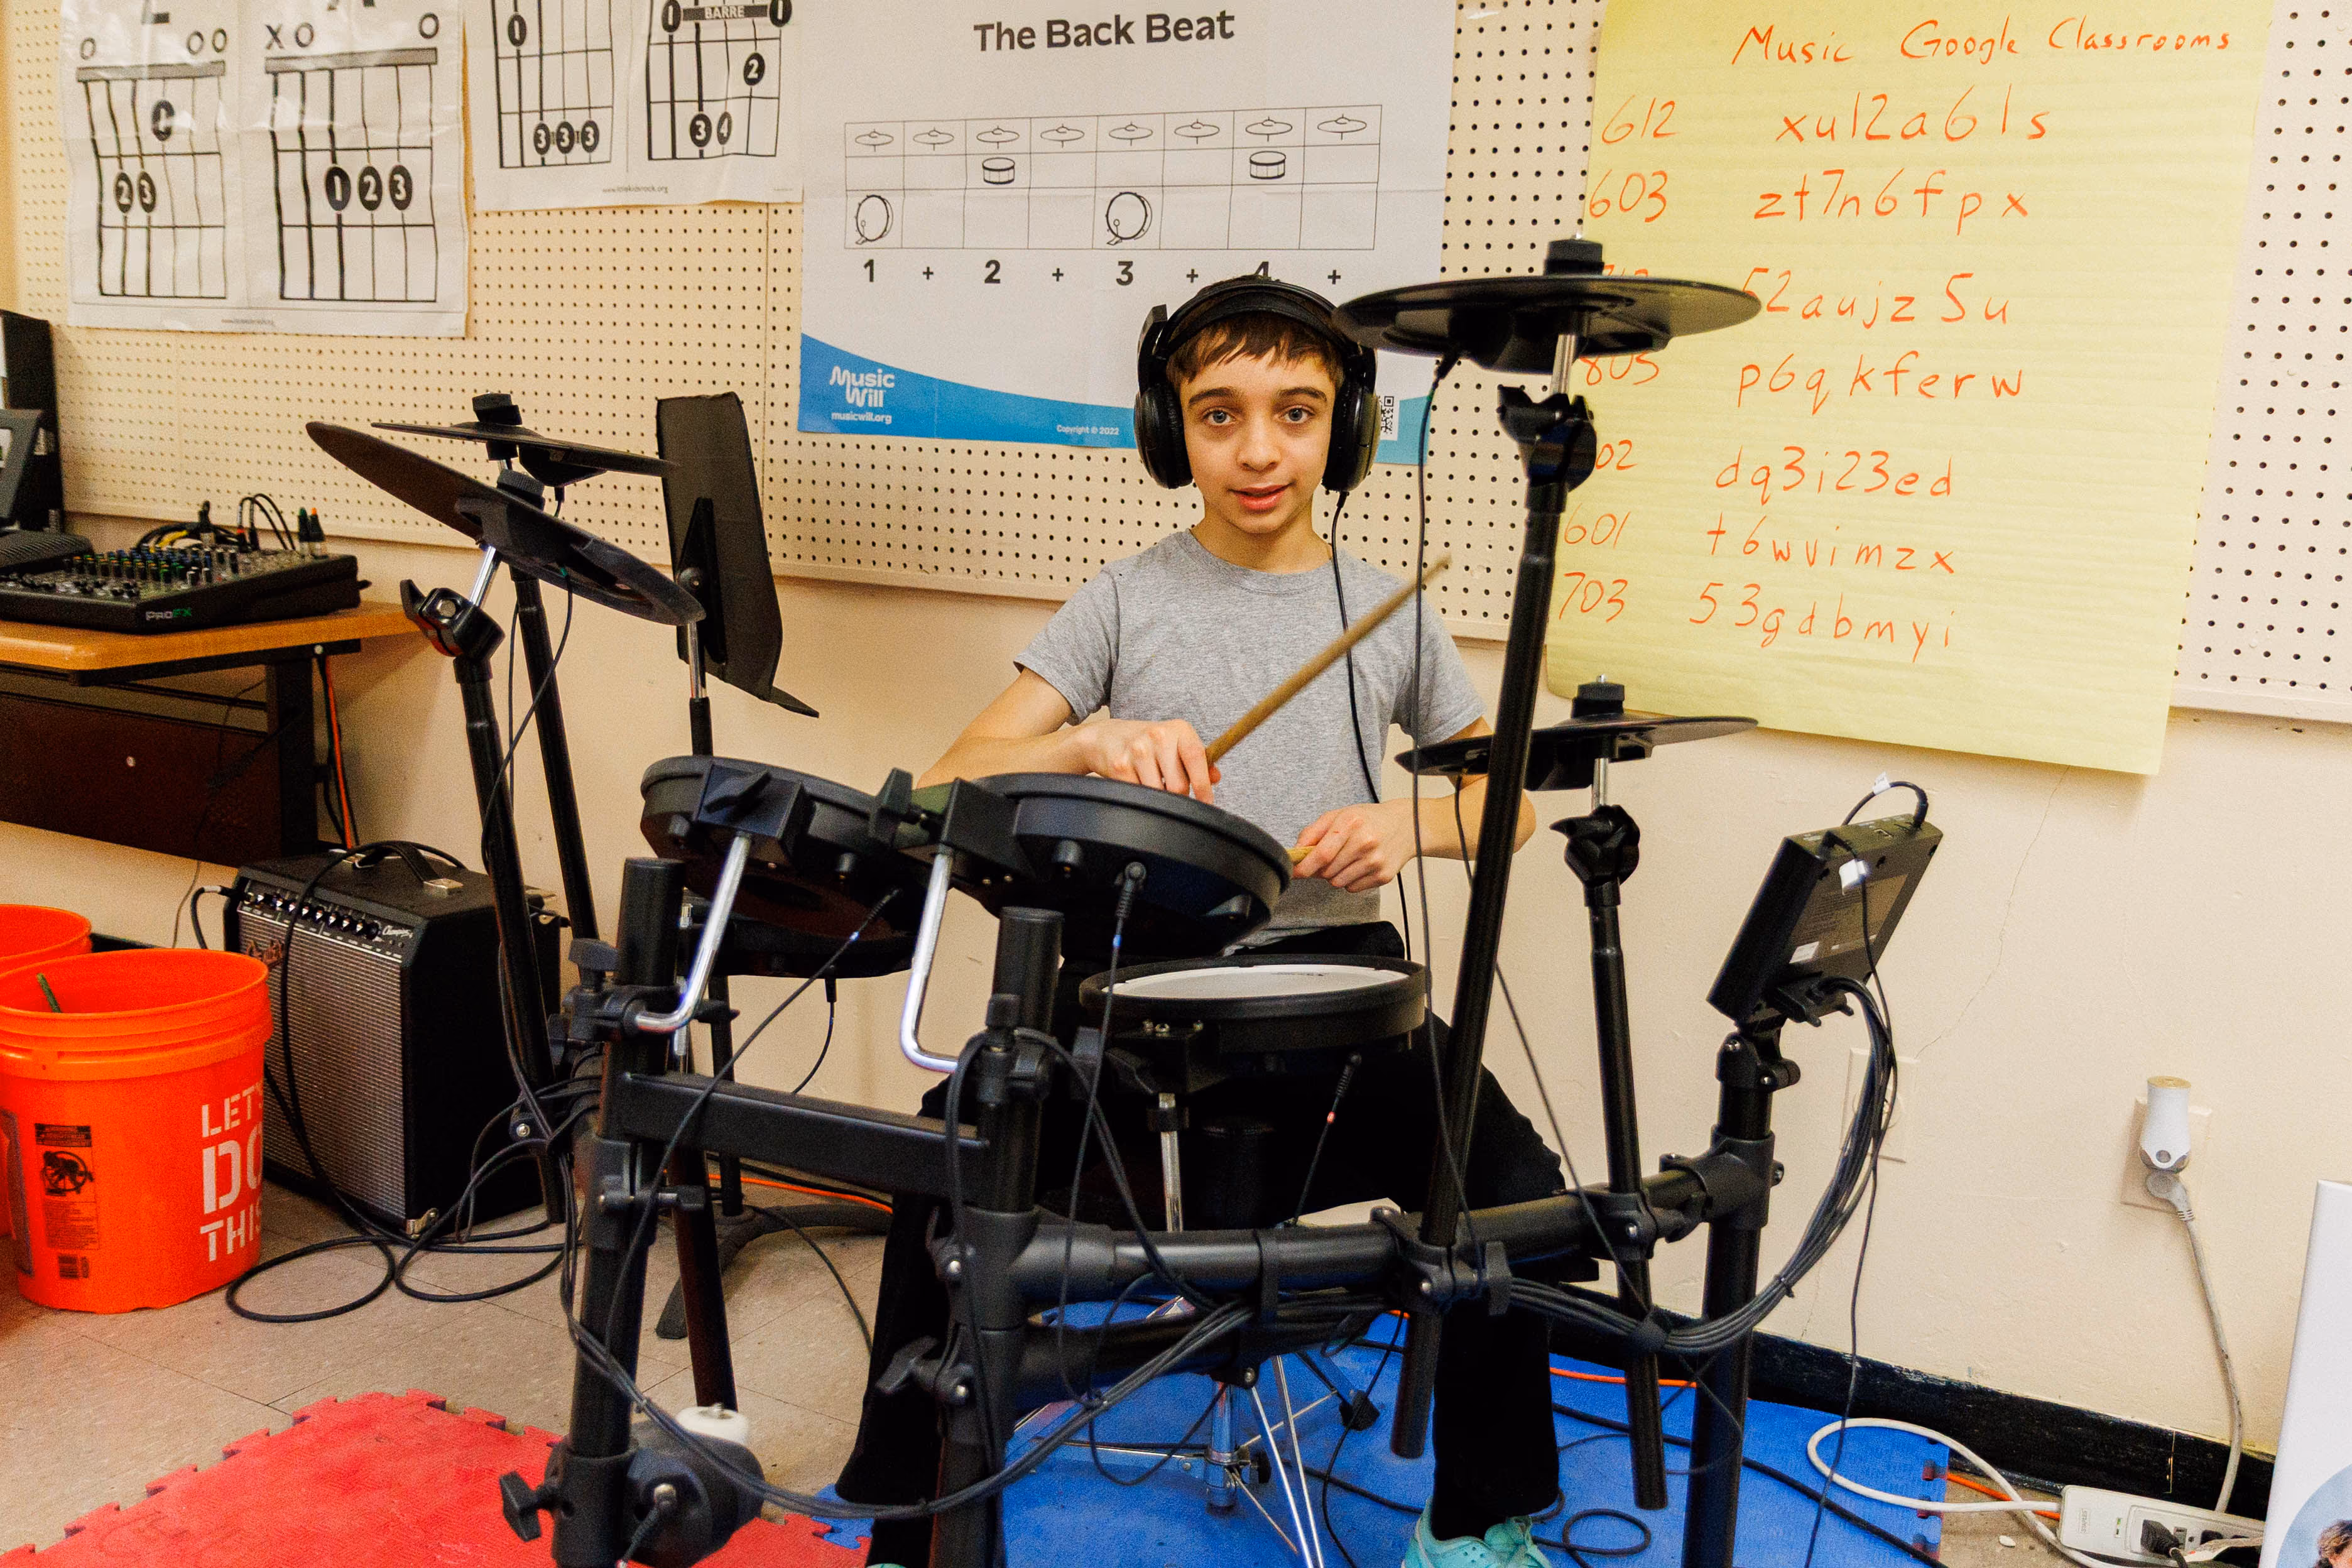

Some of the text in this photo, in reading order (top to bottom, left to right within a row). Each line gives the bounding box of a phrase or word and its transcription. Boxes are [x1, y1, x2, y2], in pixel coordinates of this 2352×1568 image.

[704, 6, 744, 19] BARRE
[973, 9, 1235, 52] The Back Beat
[1731, 14, 2231, 65] Music Google Classrooms
[1601, 97, 1677, 146] 612
[1589, 169, 1669, 224] 603
[863, 260, 875, 282] 1
[984, 260, 1001, 283] 2
[1116, 261, 1133, 286] 3
[829, 366, 895, 388] Music
[846, 388, 884, 408] Will
[831, 411, 892, 425] musicwill.org
[1057, 424, 1089, 435] Copyright
[1715, 445, 1951, 506] dq3i23ed
[1564, 511, 1631, 548] 601
[1558, 571, 1629, 624] 703
